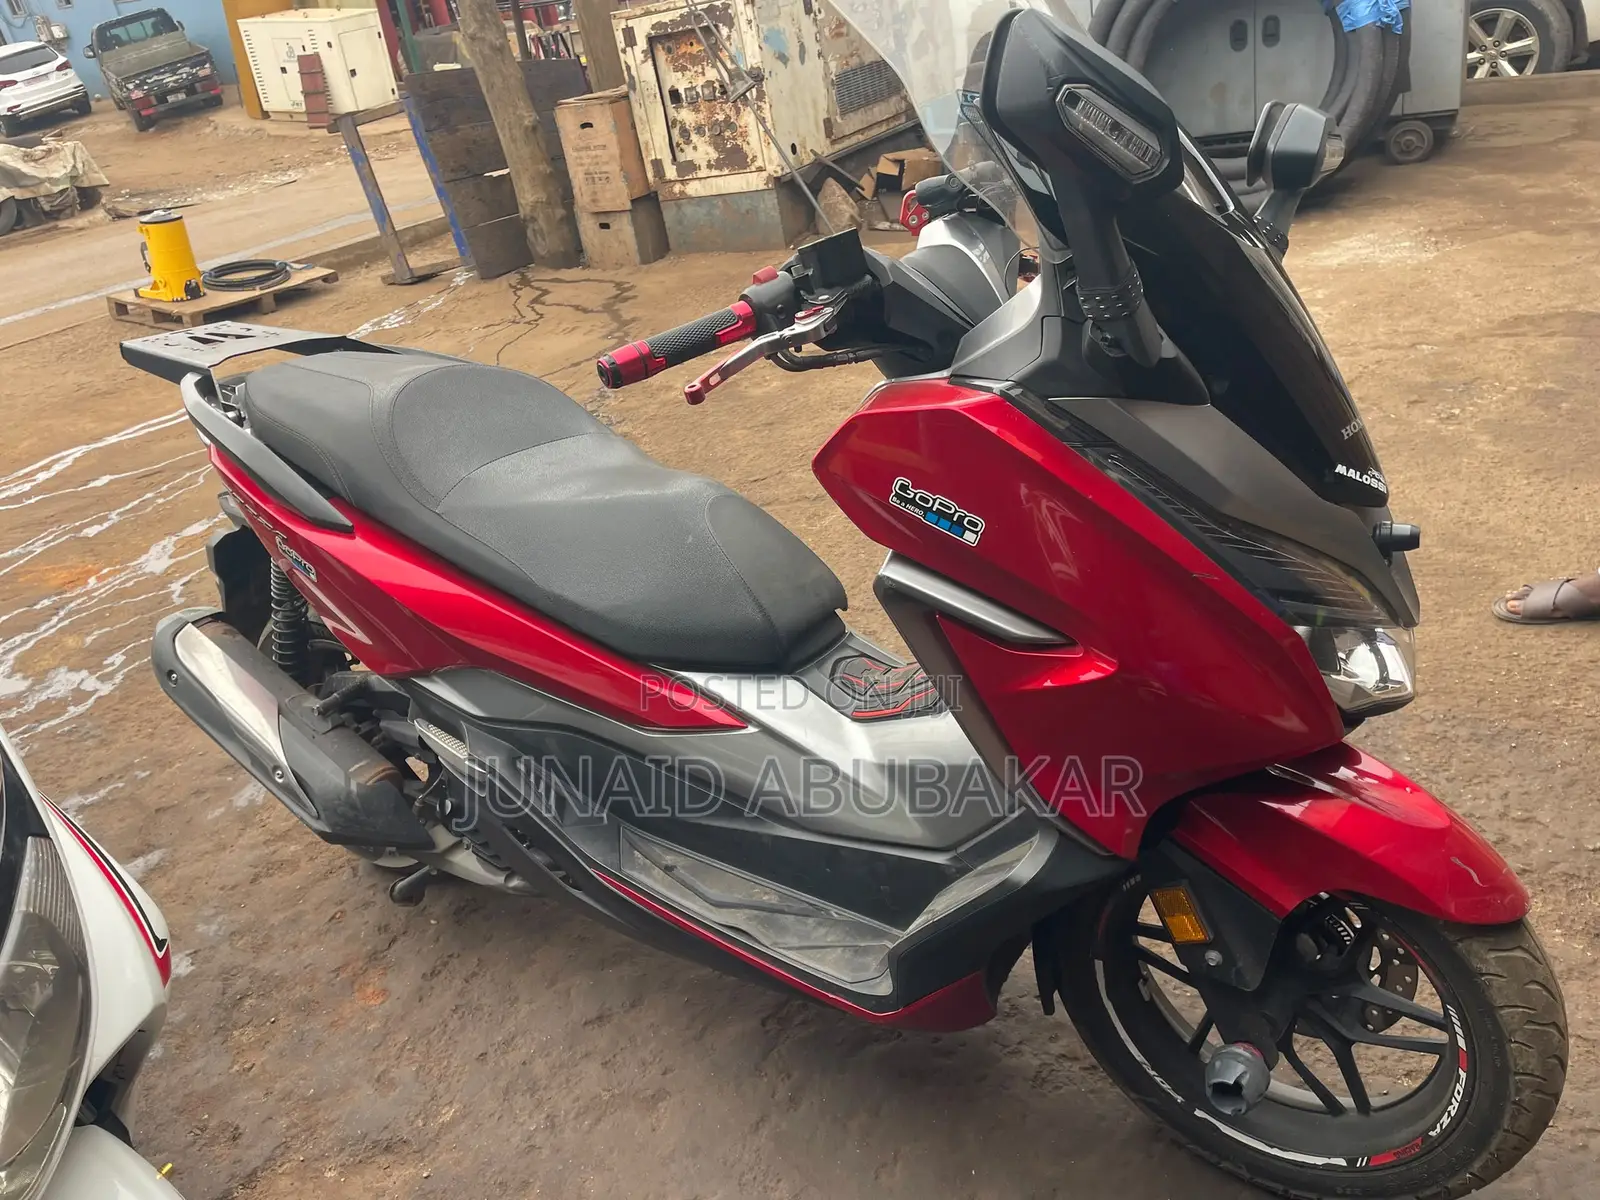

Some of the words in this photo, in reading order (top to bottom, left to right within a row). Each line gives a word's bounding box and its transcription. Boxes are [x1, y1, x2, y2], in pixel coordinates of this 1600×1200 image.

[1334, 463, 1387, 494] MALOSSI
[892, 496, 901, 504] Be
[895, 479, 984, 533] GoPro
[276, 536, 316, 574] GoPro
[1428, 1067, 1467, 1137] FORZA
